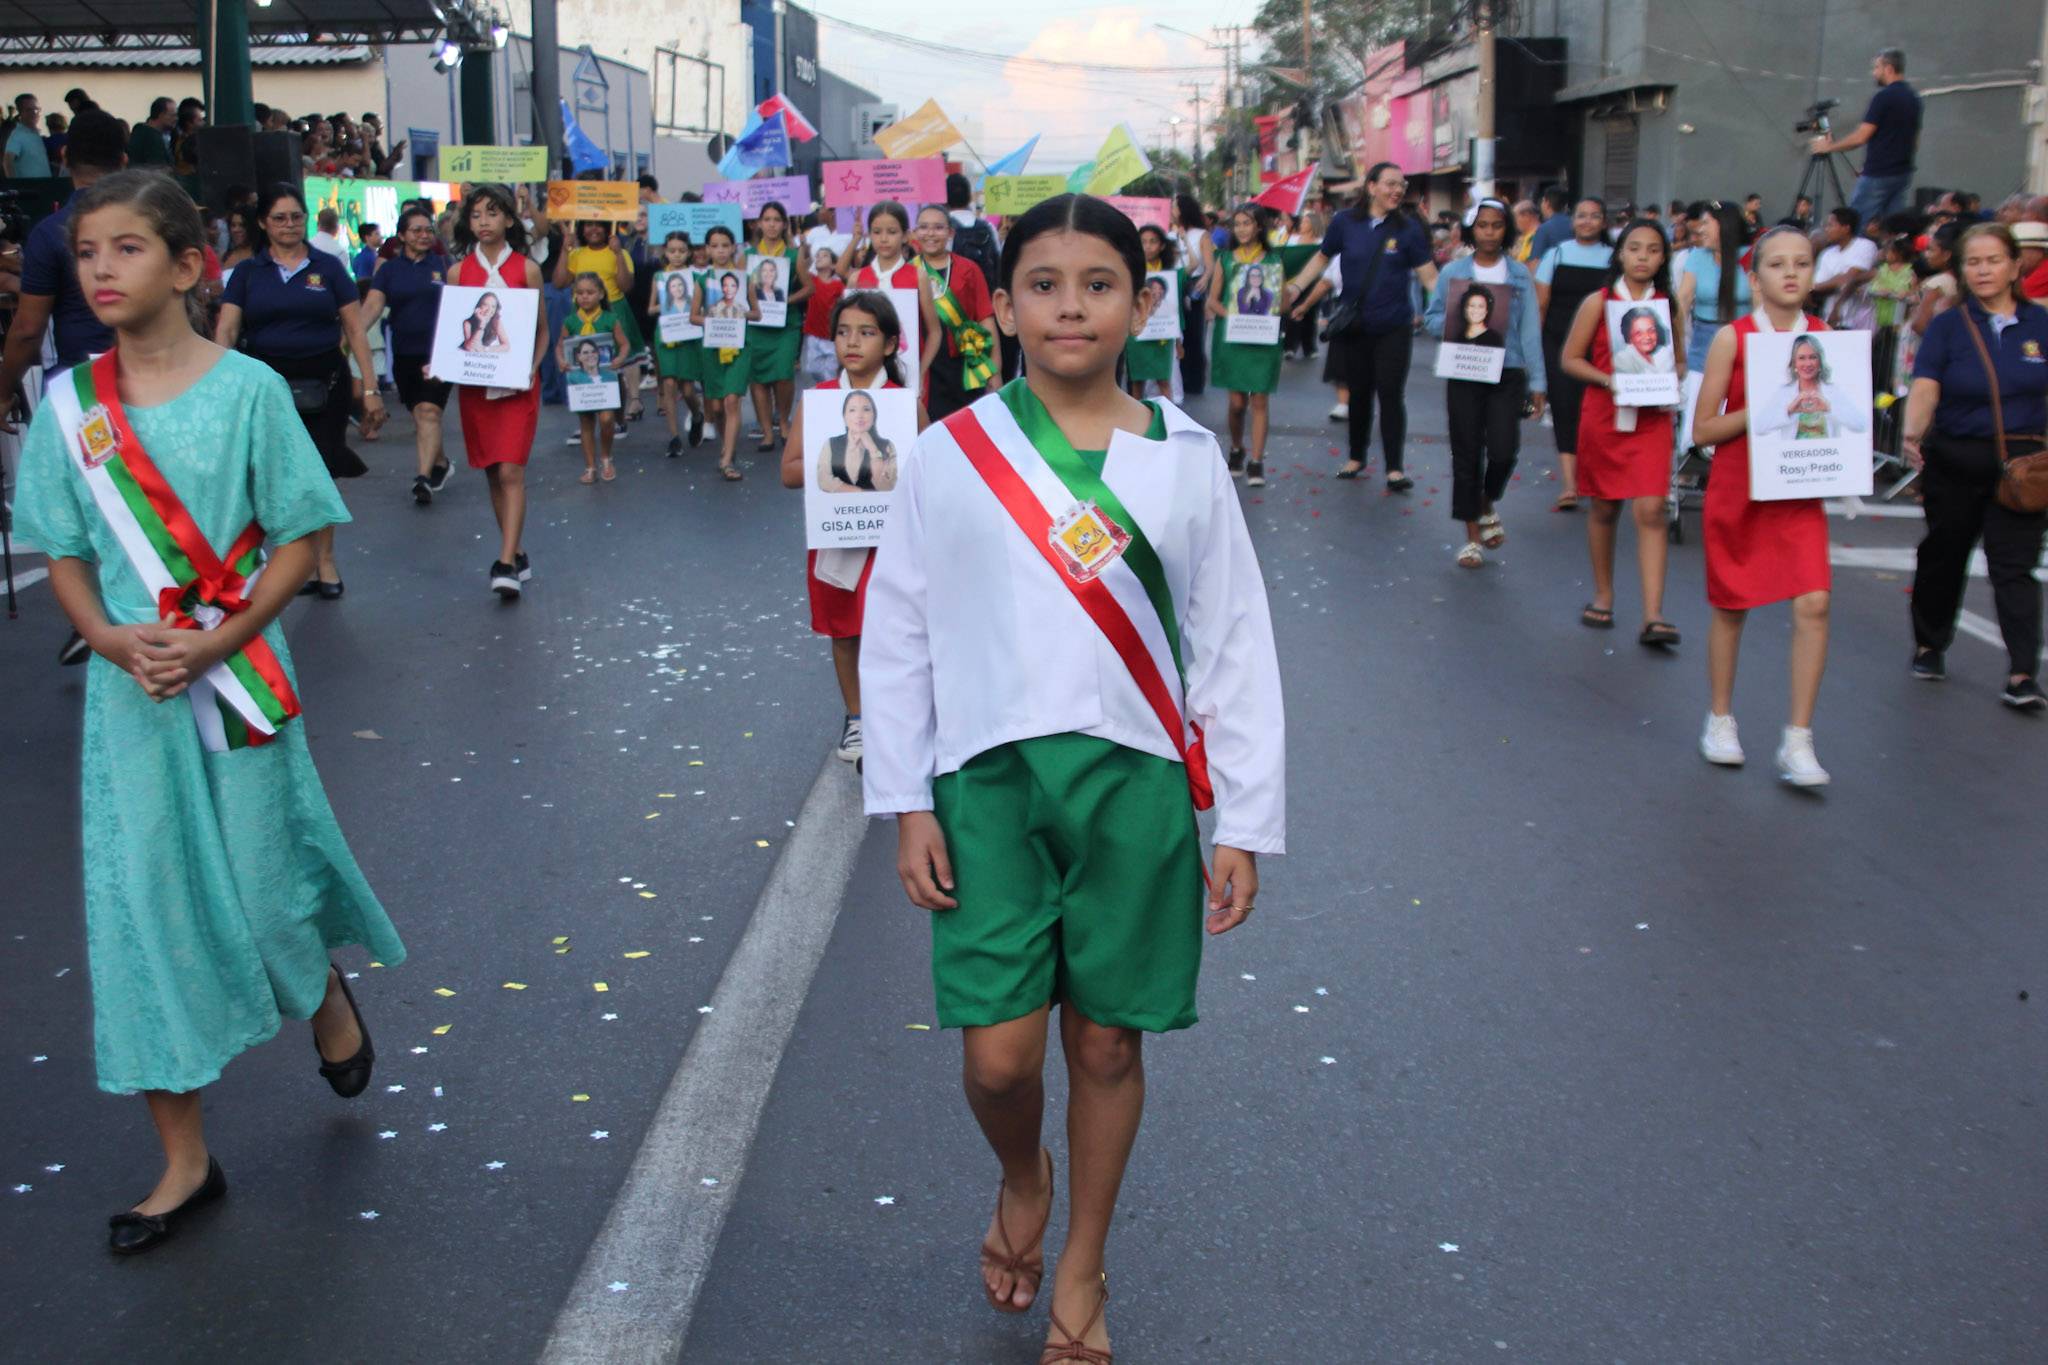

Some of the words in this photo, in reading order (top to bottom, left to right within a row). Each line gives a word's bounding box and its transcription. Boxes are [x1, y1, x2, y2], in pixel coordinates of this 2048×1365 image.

[464, 361, 497, 372] Michelly
[464, 370, 495, 379] Alencar
[1782, 448, 1840, 459] VEREADORA
[1780, 465, 1808, 476] Rosy
[1810, 462, 1843, 472] Prado
[821, 520, 853, 532] GISA
